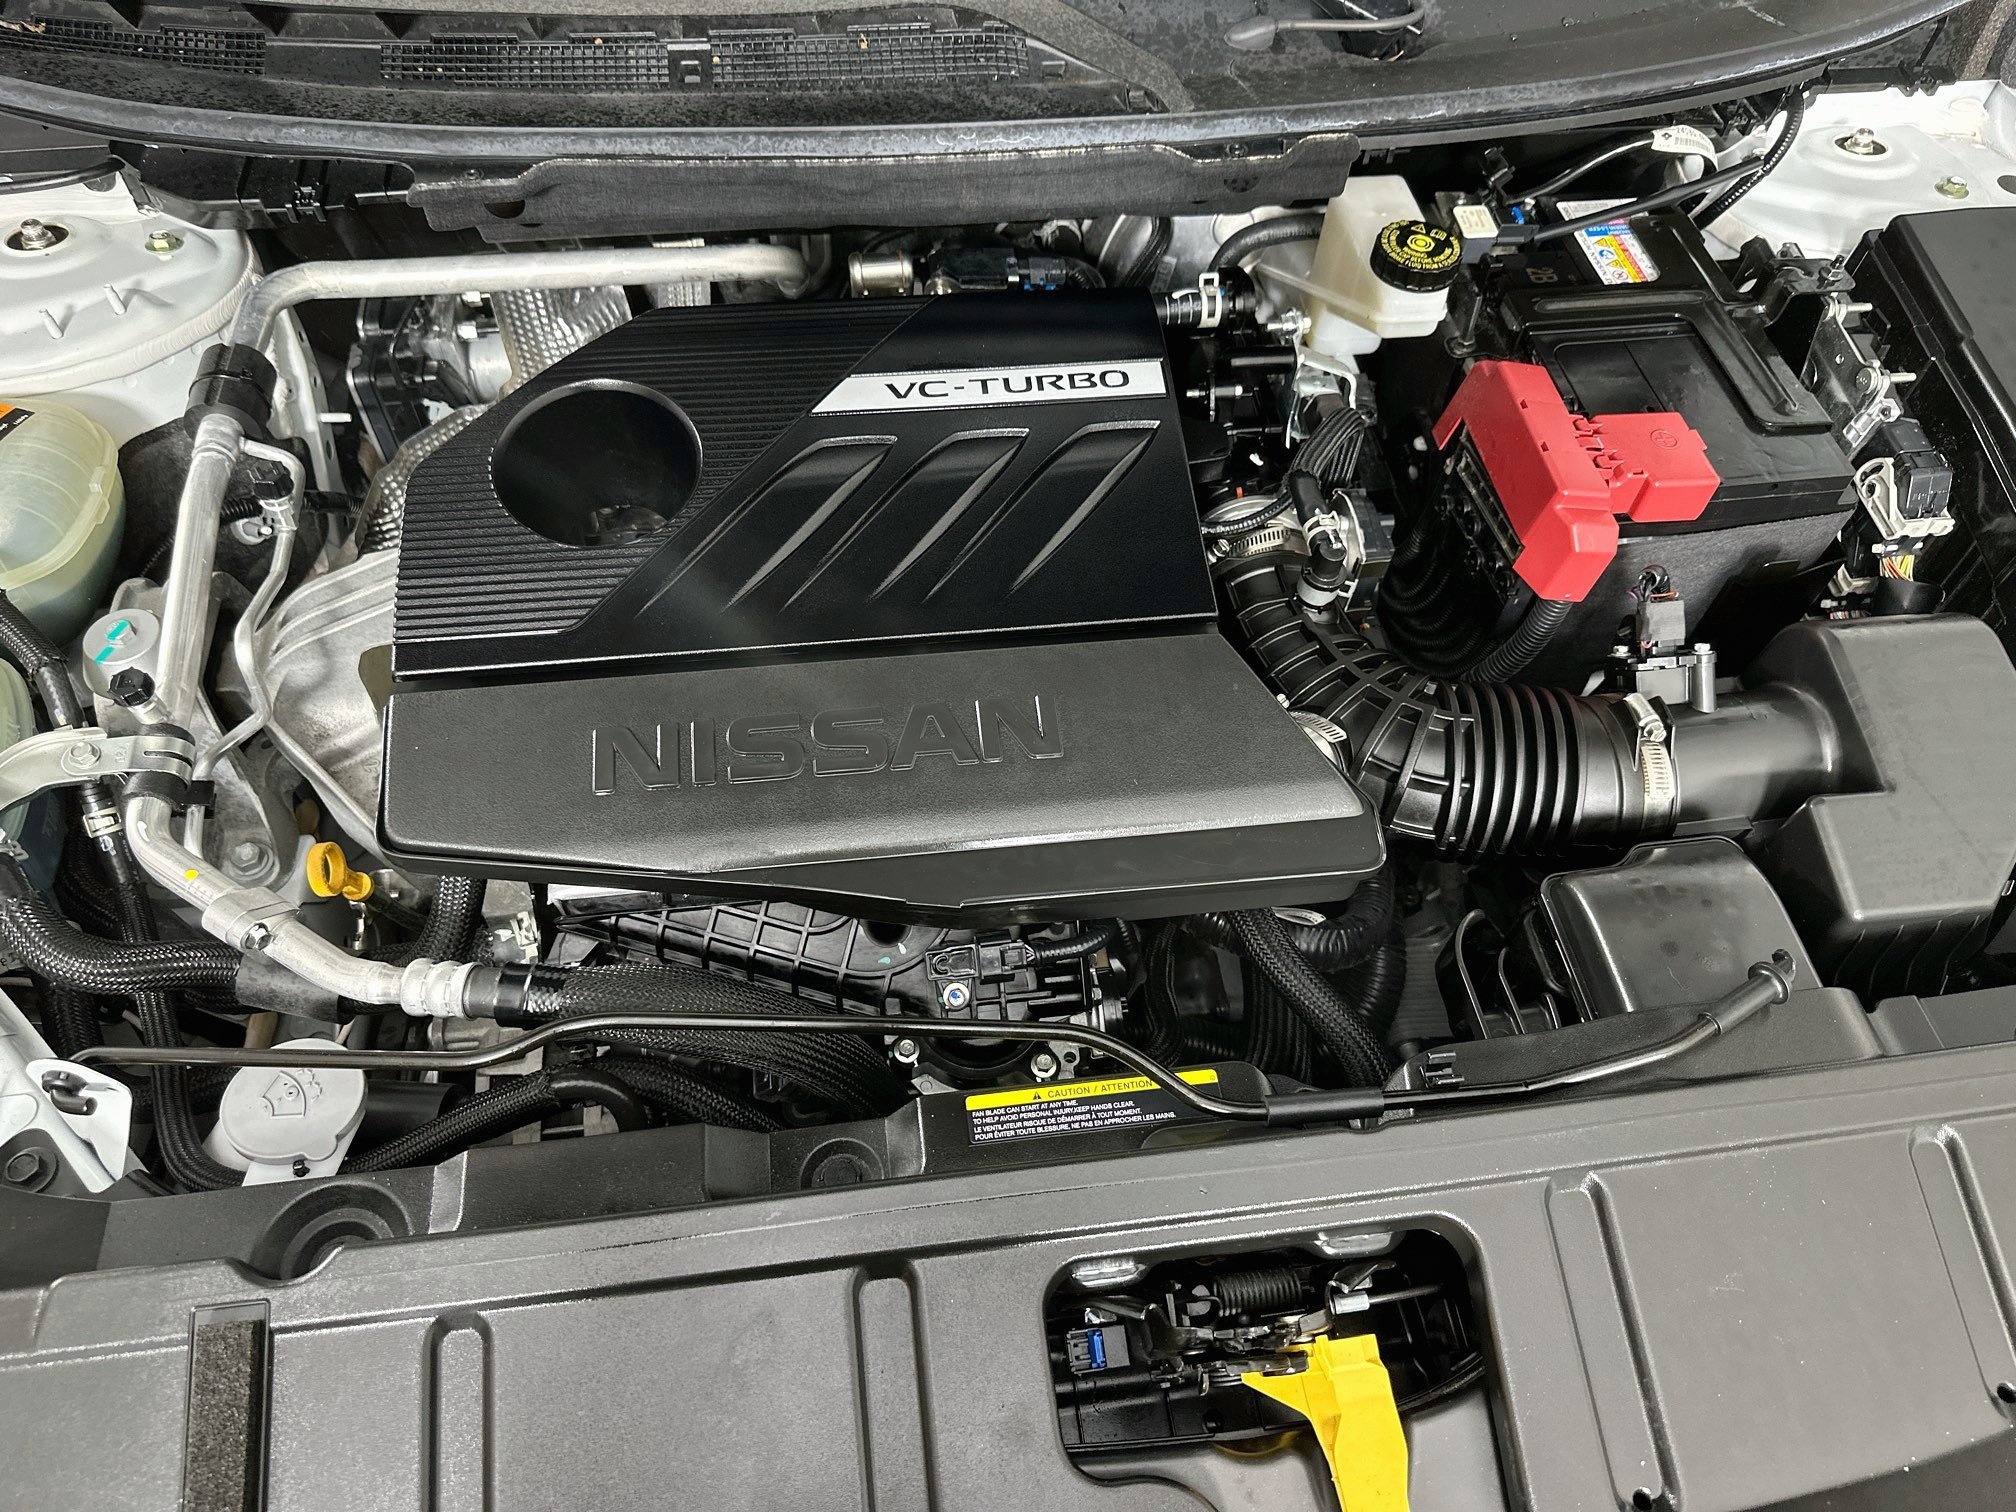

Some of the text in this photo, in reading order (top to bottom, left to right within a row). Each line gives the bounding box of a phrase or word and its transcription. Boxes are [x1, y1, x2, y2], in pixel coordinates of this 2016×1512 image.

[884, 369, 1131, 399] VC-TURBO
[591, 694, 1065, 797] NISSAN
[1048, 1086, 1091, 1098] CAUTION
[1101, 1079, 1153, 1092] ATTENTION
[983, 1116, 999, 1124] HELP
[999, 1113, 1019, 1122] AVOID
[1020, 1110, 1052, 1120] PERSONAL
[1091, 1101, 1112, 1111] HANDS
[1113, 1100, 1135, 1108] CLEAR.
[985, 1107, 1005, 1116] BLADE
[1006, 1106, 1020, 1114] CAN
[1021, 1104, 1040, 1112] START
[1049, 1101, 1061, 1109] ANY
[1063, 1099, 1079, 1107] TIME.
[975, 1132, 993, 1140] POUR
[994, 1129, 1015, 1139] ÉVITER
[1016, 1127, 1036, 1136] TOUTE
[1037, 1124, 1070, 1133] BLESSURE,
[1081, 1120, 1093, 1128] PAS
[1104, 1115, 1142, 1126] APPROCHER
[1155, 1111, 1176, 1119] MAINS.
[982, 1121, 1023, 1132] VENTILATEUR
[1023, 1118, 1047, 1127] RISQUE
[1057, 1112, 1091, 1123] DÉMARRER
[1097, 1110, 1113, 1118] TOUT
[1114, 1108, 1142, 1116] MOMENT.
